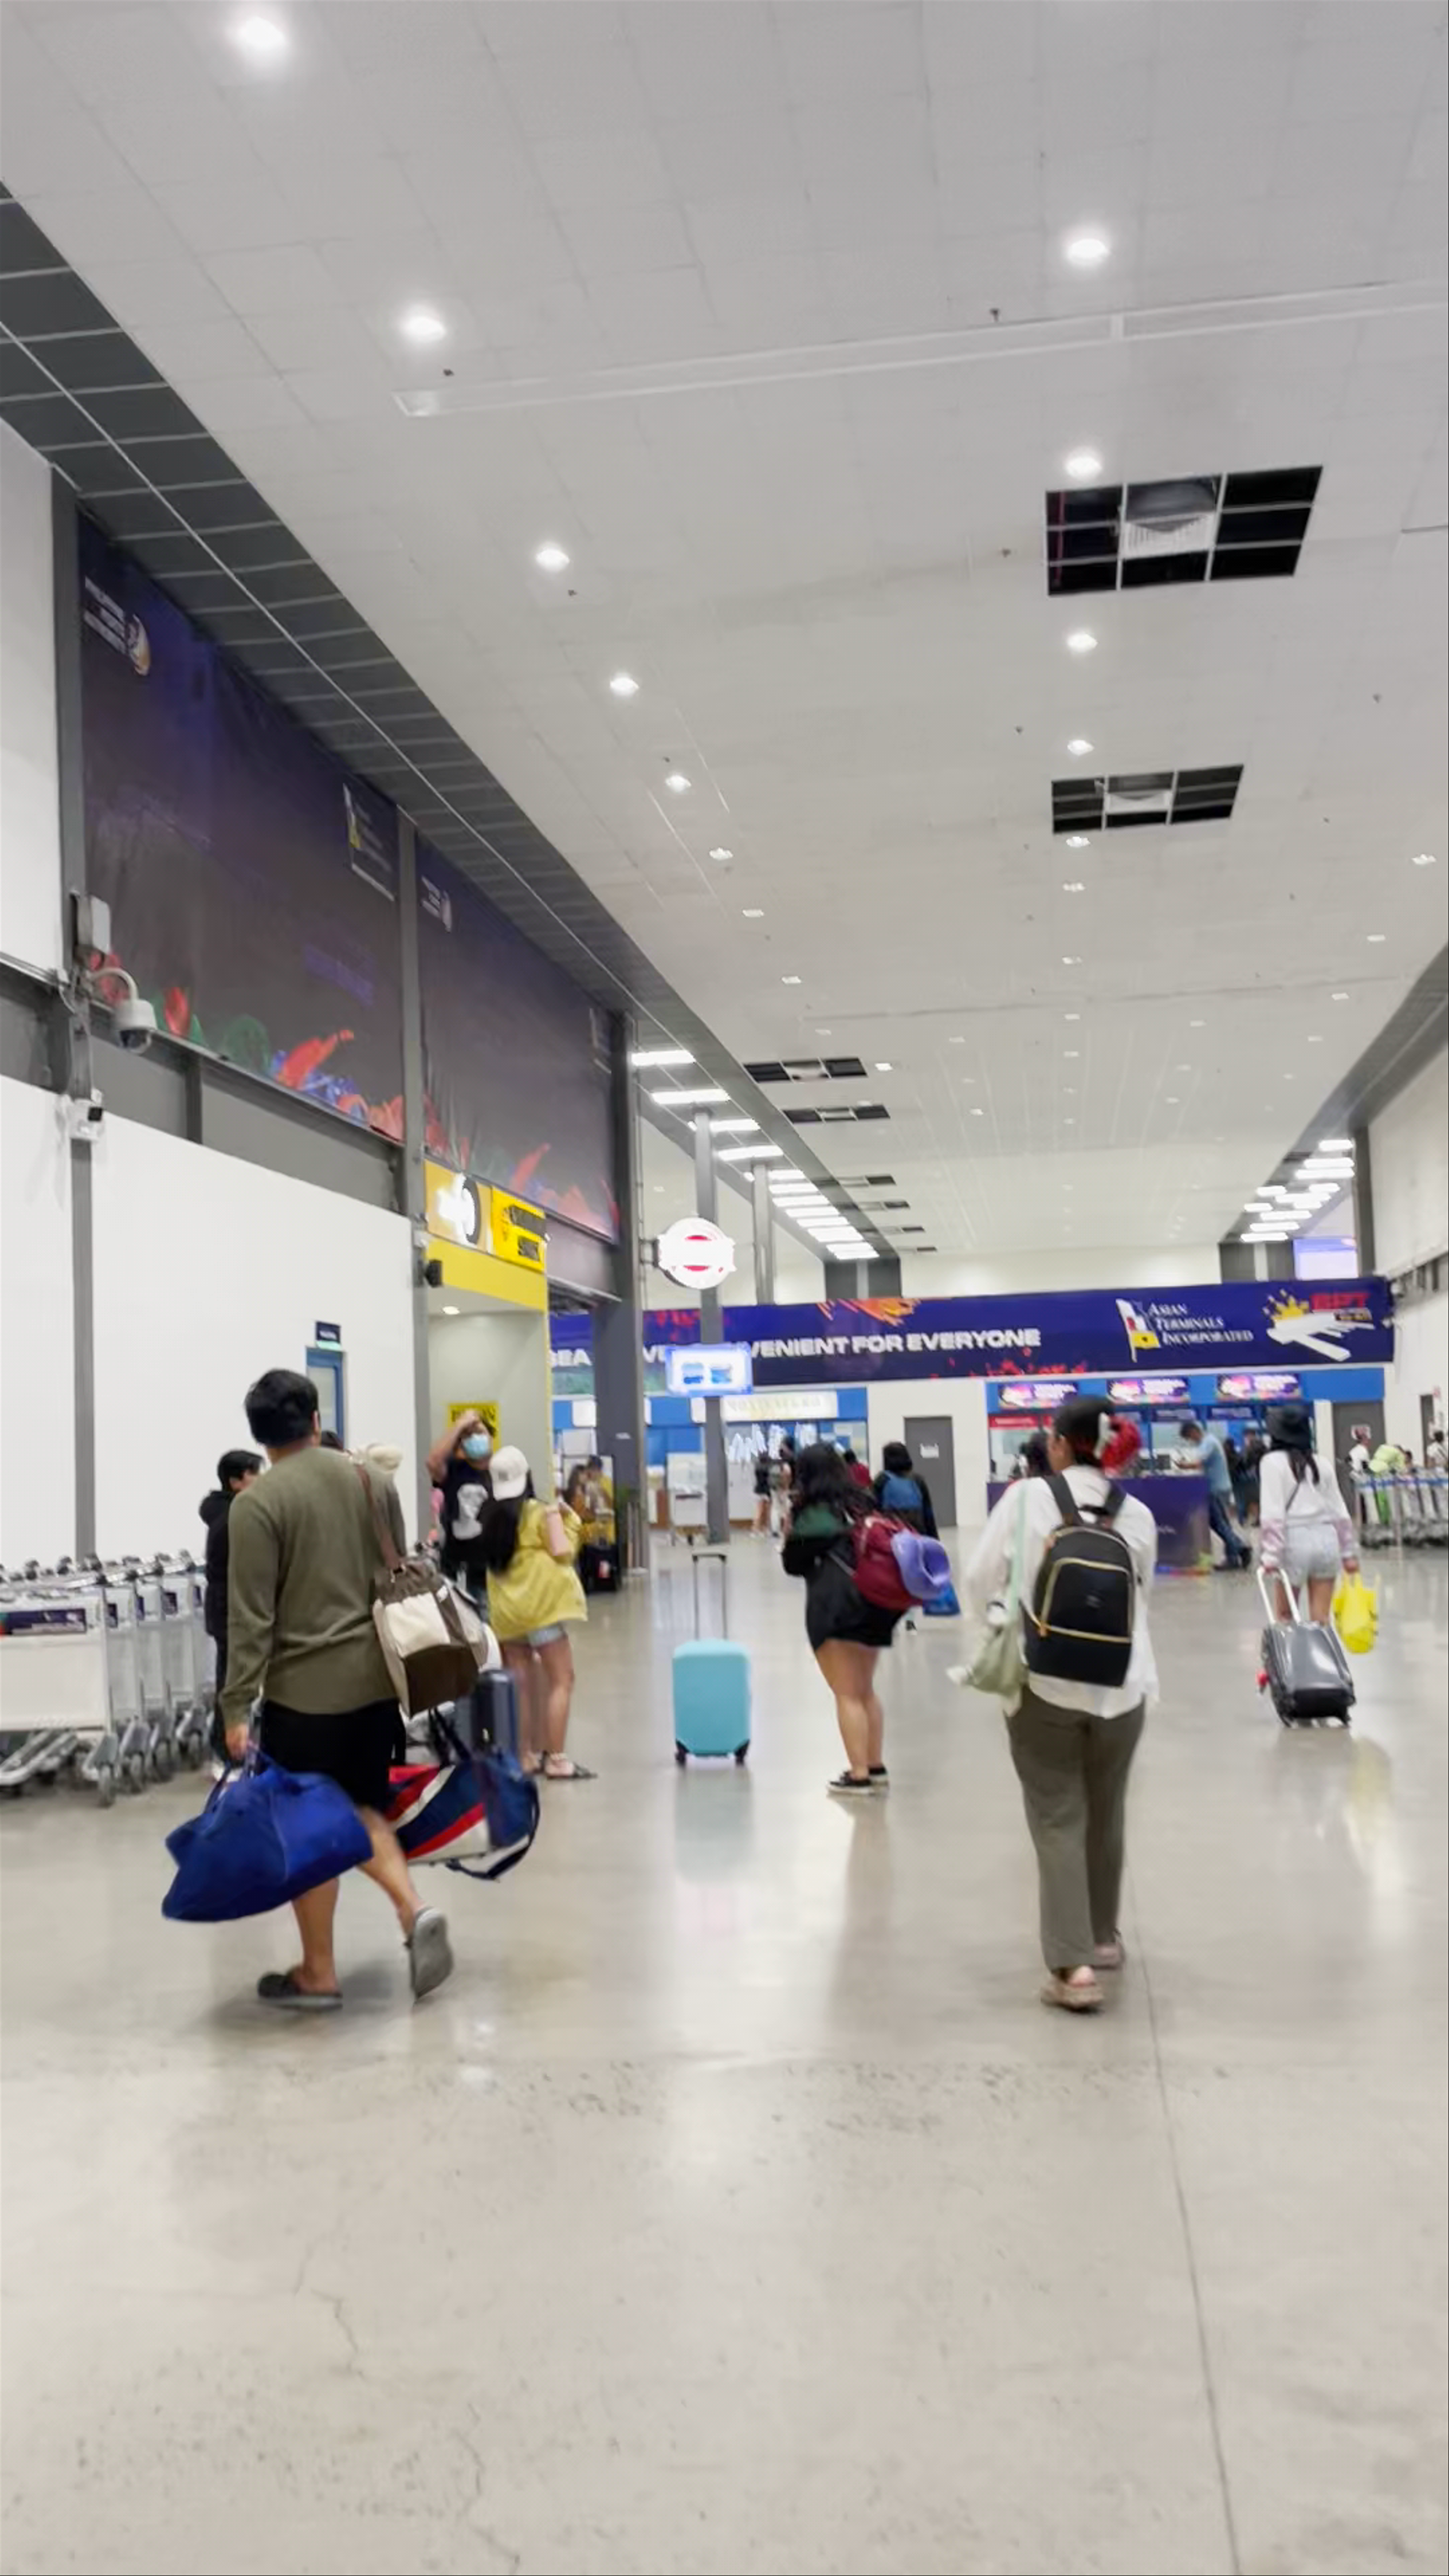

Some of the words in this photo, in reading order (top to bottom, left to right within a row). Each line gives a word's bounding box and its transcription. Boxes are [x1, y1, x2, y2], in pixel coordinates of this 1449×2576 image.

[1154, 1315, 1224, 1331] TERMINALS
[851, 1334, 904, 1353] FOR
[906, 1328, 1041, 1351] EVERYONE
[1162, 1330, 1254, 1345] INCORPORATED
